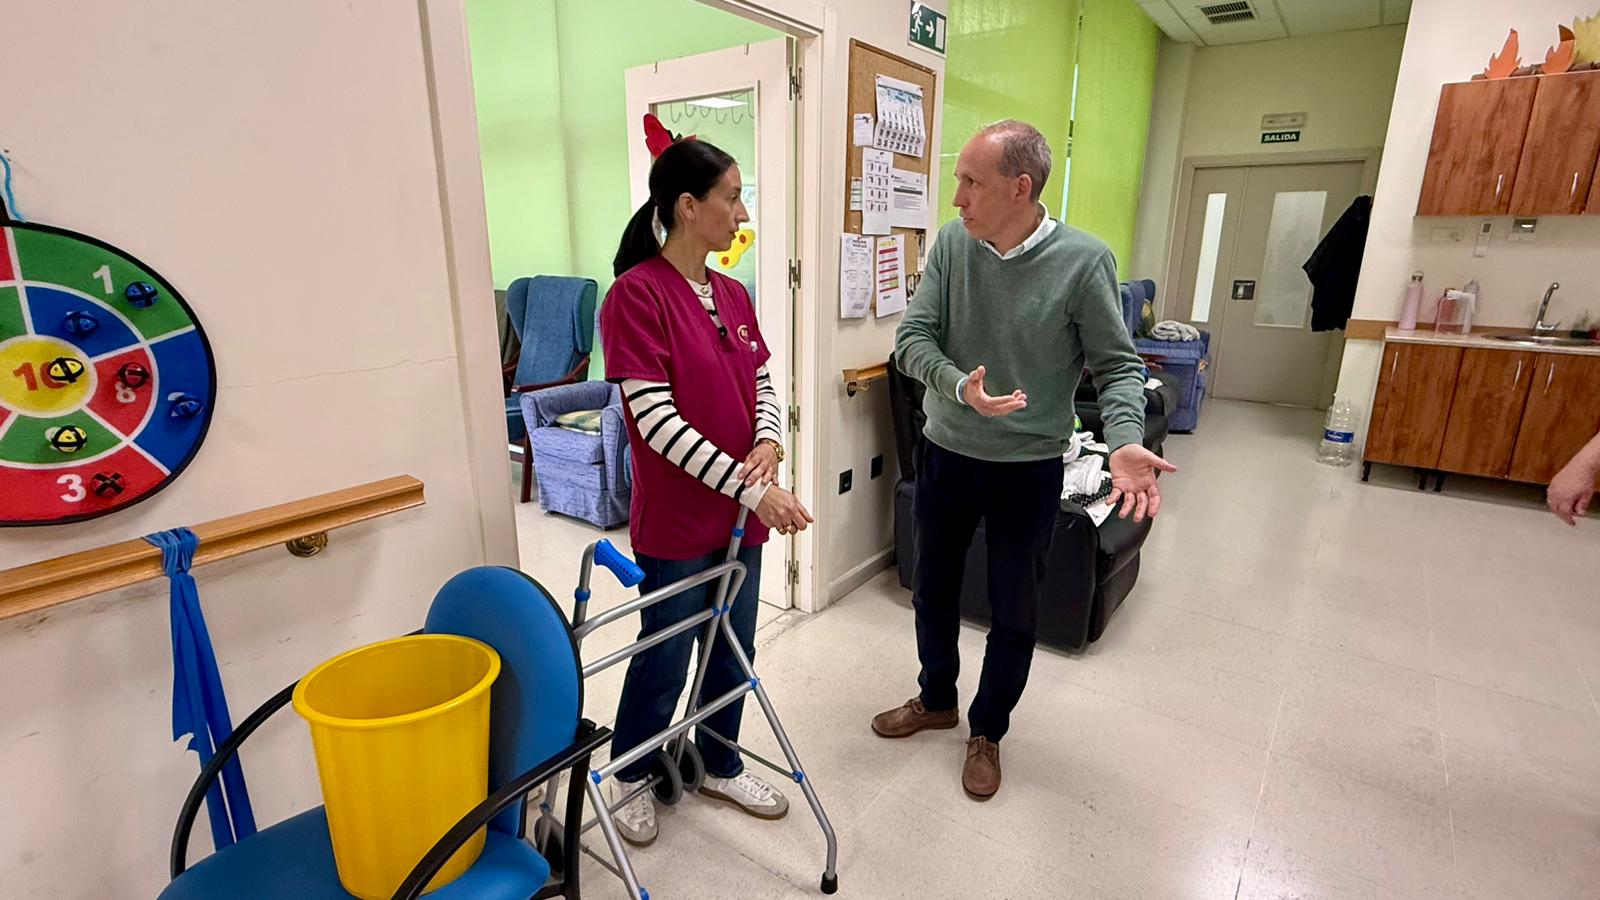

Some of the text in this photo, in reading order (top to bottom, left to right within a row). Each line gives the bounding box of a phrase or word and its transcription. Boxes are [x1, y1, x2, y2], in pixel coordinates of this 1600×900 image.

[1264, 134, 1297, 142] SALIDA
[93, 265, 114, 294] 1
[57, 474, 87, 503] 3
